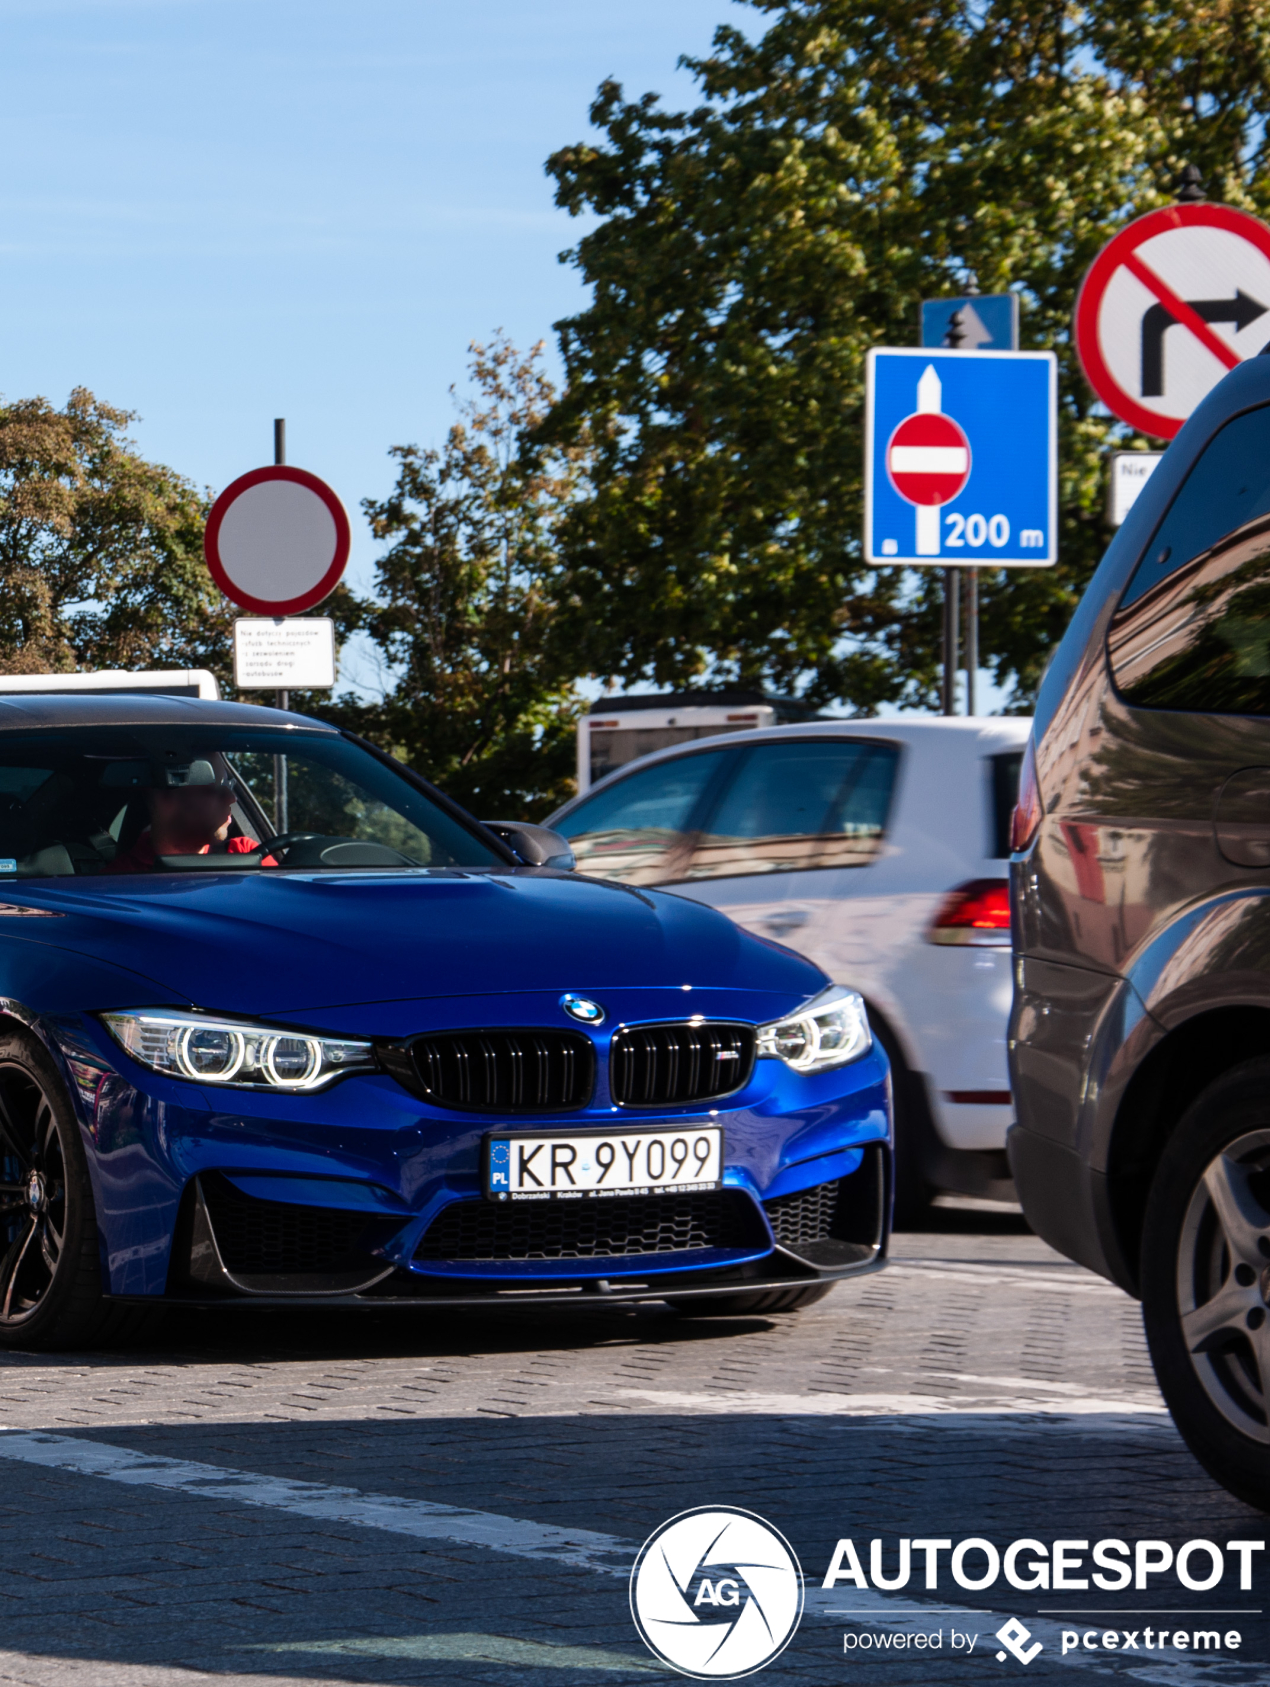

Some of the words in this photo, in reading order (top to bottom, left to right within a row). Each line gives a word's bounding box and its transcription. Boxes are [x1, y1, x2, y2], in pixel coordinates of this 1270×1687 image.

[1122, 464, 1147, 476] Nie
[944, 512, 1011, 548] 200
[1019, 529, 1044, 548] m
[518, 1143, 577, 1188] KR
[595, 1136, 711, 1184] 9Y099
[492, 1172, 508, 1184] PL
